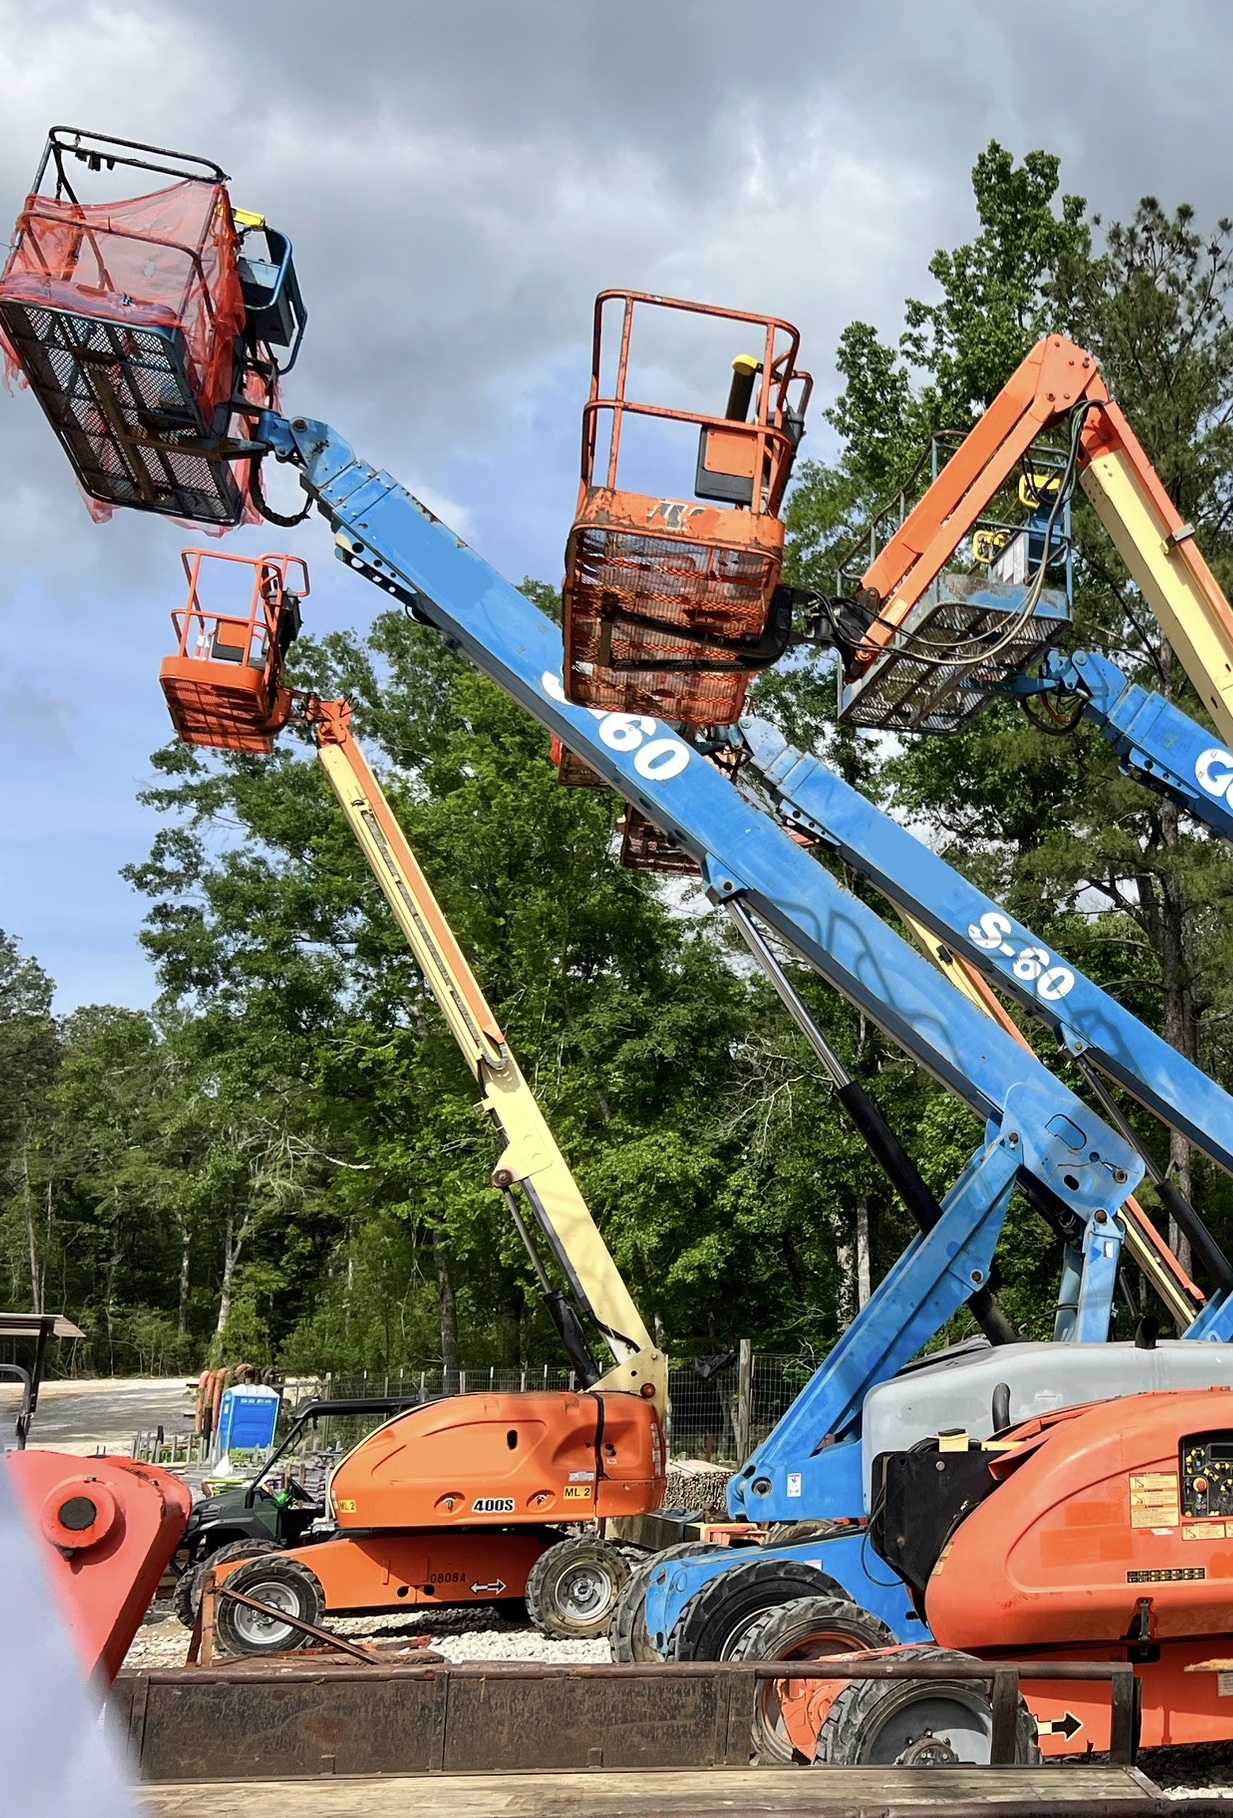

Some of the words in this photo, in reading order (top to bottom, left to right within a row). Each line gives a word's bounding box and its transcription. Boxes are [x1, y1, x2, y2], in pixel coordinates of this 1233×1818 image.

[968, 912, 1075, 1000] S-60
[564, 1487, 580, 1497] ML
[584, 1487, 591, 1497] 2
[339, 1501, 349, 1511] ML
[350, 1501, 355, 1511] 2
[472, 1498, 515, 1513] 400S
